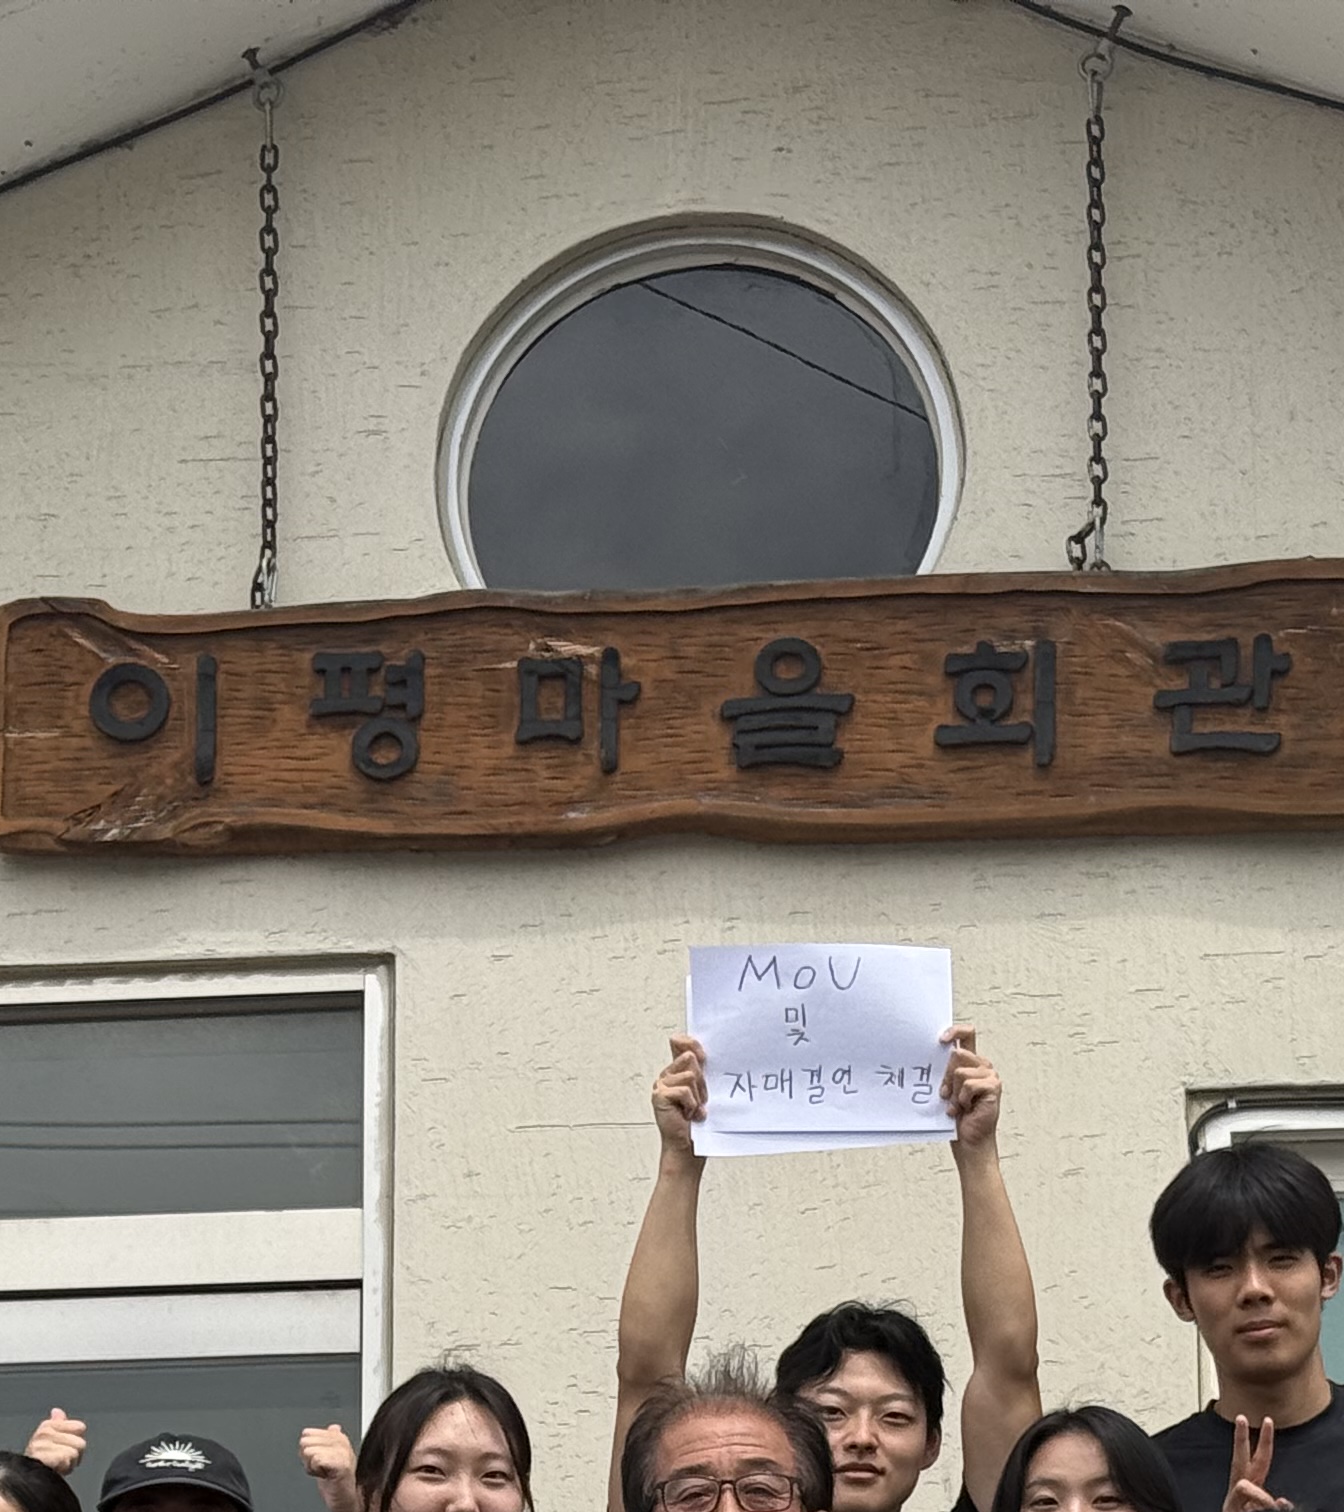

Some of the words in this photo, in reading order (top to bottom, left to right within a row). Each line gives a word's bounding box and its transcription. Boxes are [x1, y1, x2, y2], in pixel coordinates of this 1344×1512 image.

[784, 1002, 810, 1046] 및
[723, 1063, 859, 1105] 자매결연
[874, 1063, 933, 1105] 체결
